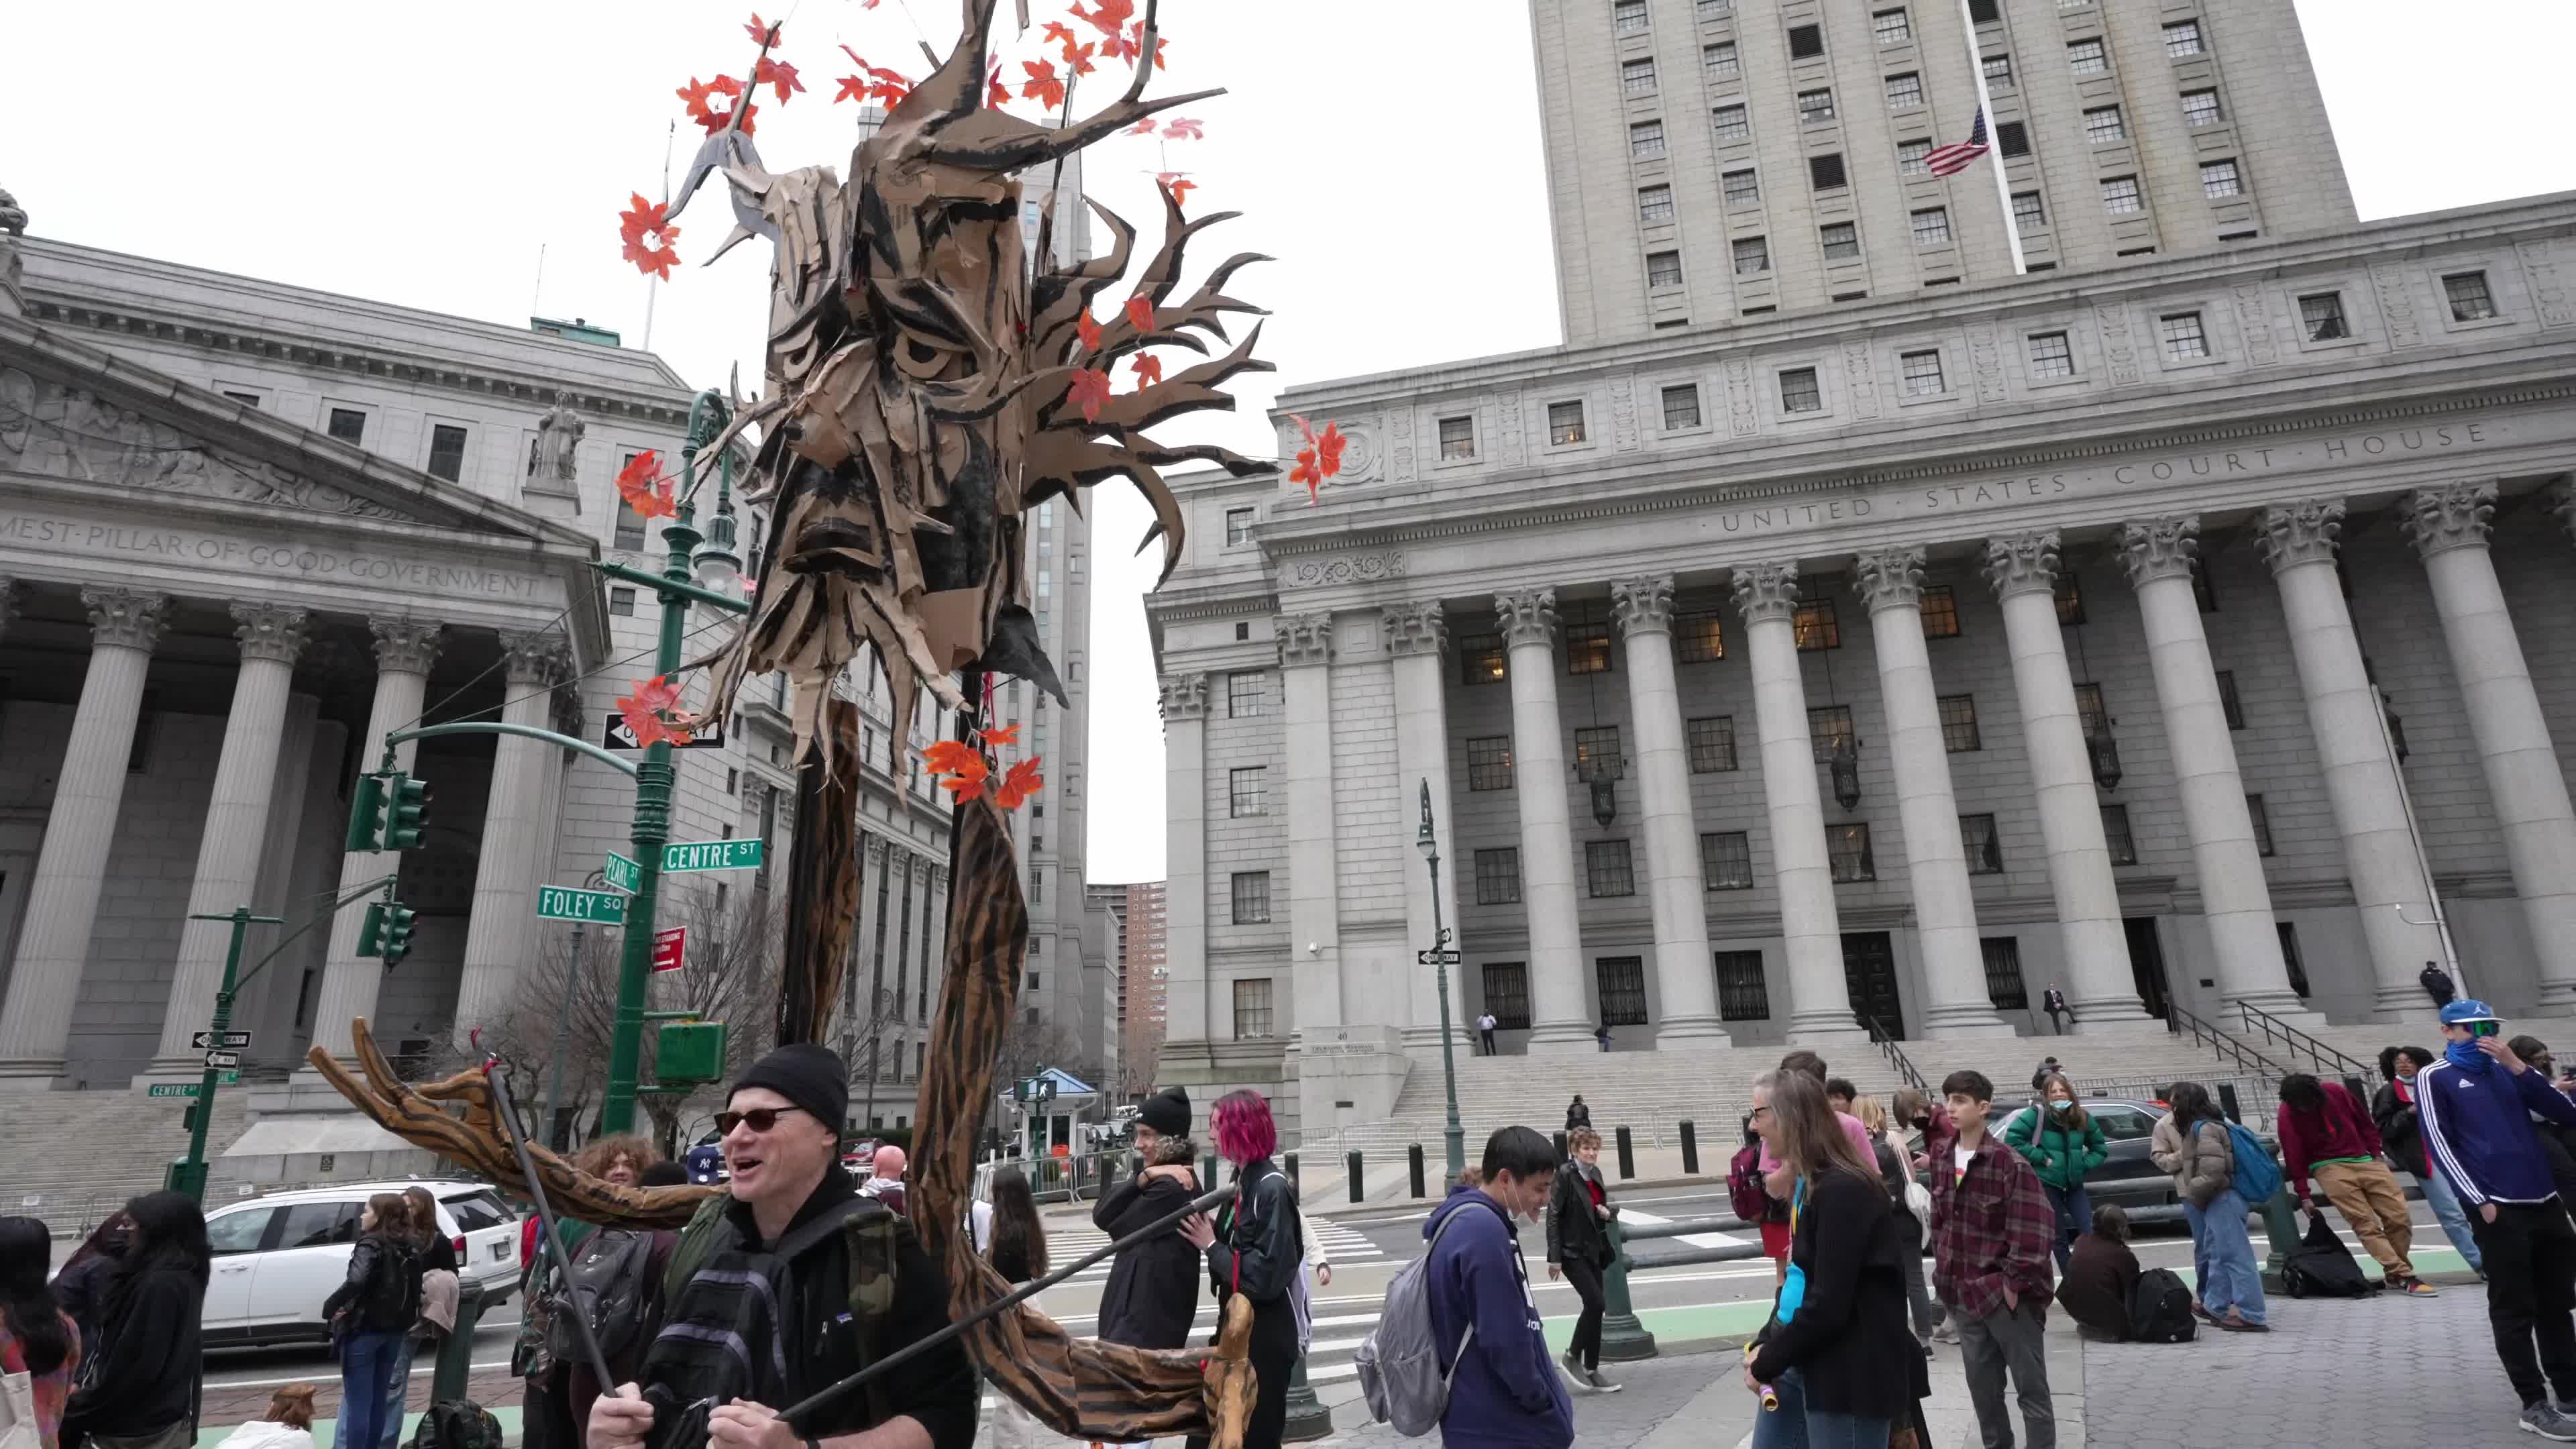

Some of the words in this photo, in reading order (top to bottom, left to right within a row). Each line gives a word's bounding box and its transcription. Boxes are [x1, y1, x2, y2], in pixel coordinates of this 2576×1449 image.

[1722, 498, 1870, 531] UNITED
[1926, 474, 2066, 508] STATES
[2114, 449, 2275, 484] COURT
[2324, 423, 2486, 460] HOUSE
[85, 525, 185, 557] PILLAR
[196, 539, 239, 561] OF
[248, 545, 335, 572] GOOD
[349, 557, 538, 596] GOVERNMENT
[606, 855, 627, 886] PEARL
[631, 867, 639, 879] ST
[667, 844, 733, 869] CENTRE
[739, 843, 756, 854] ST
[543, 890, 596, 918] FOLEY
[603, 897, 621, 910] SQ
[153, 1085, 187, 1095] CENTRE
